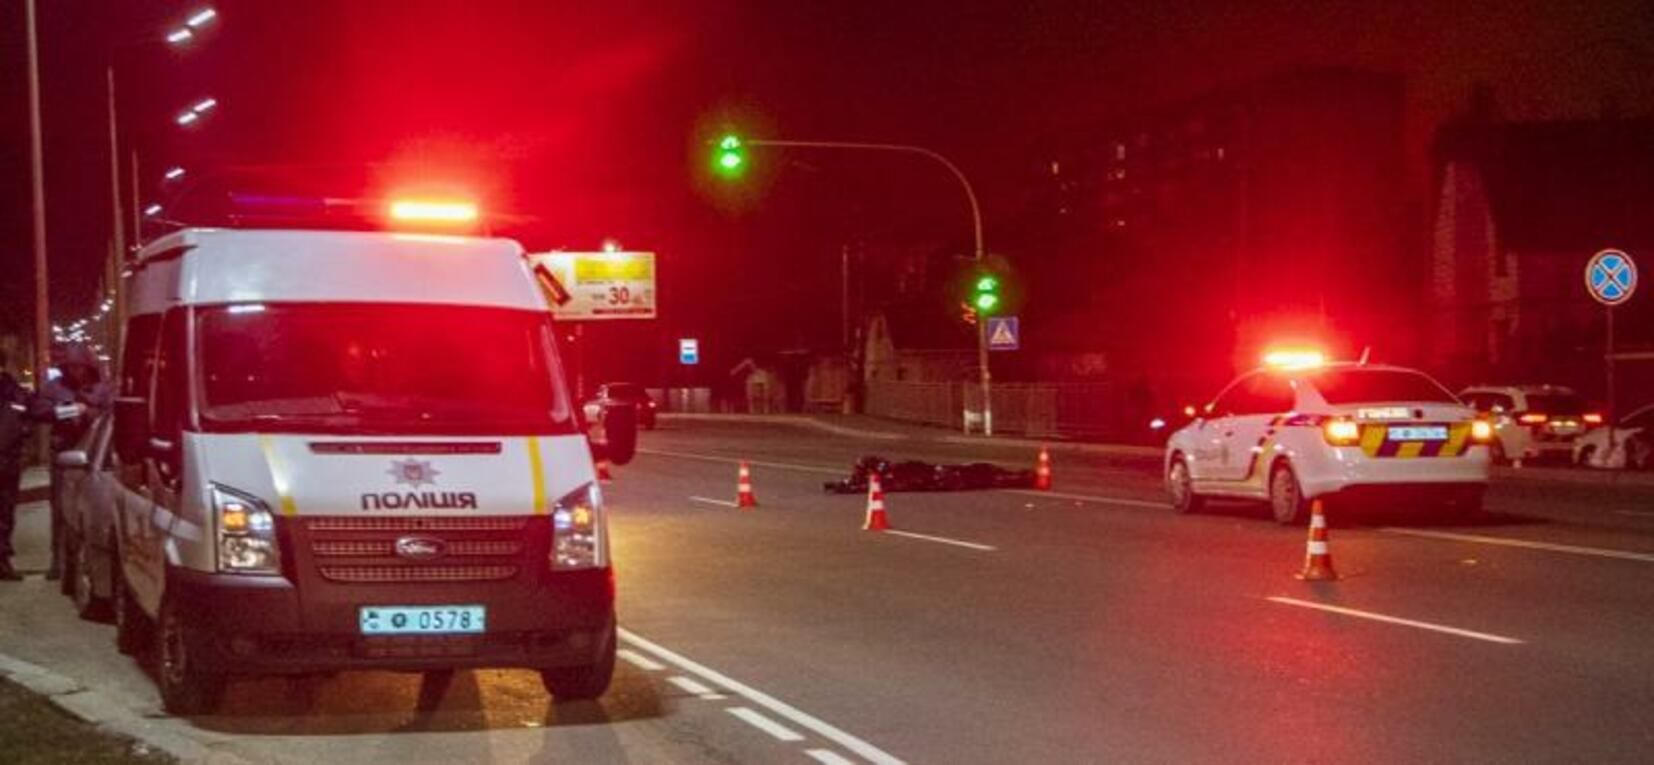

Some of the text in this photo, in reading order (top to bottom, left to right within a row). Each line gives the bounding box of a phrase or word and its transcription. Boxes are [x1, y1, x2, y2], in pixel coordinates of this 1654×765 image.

[609, 286, 629, 304] 30
[361, 492, 477, 510] ПОЛІЦІЯ
[419, 611, 470, 629] 0578
